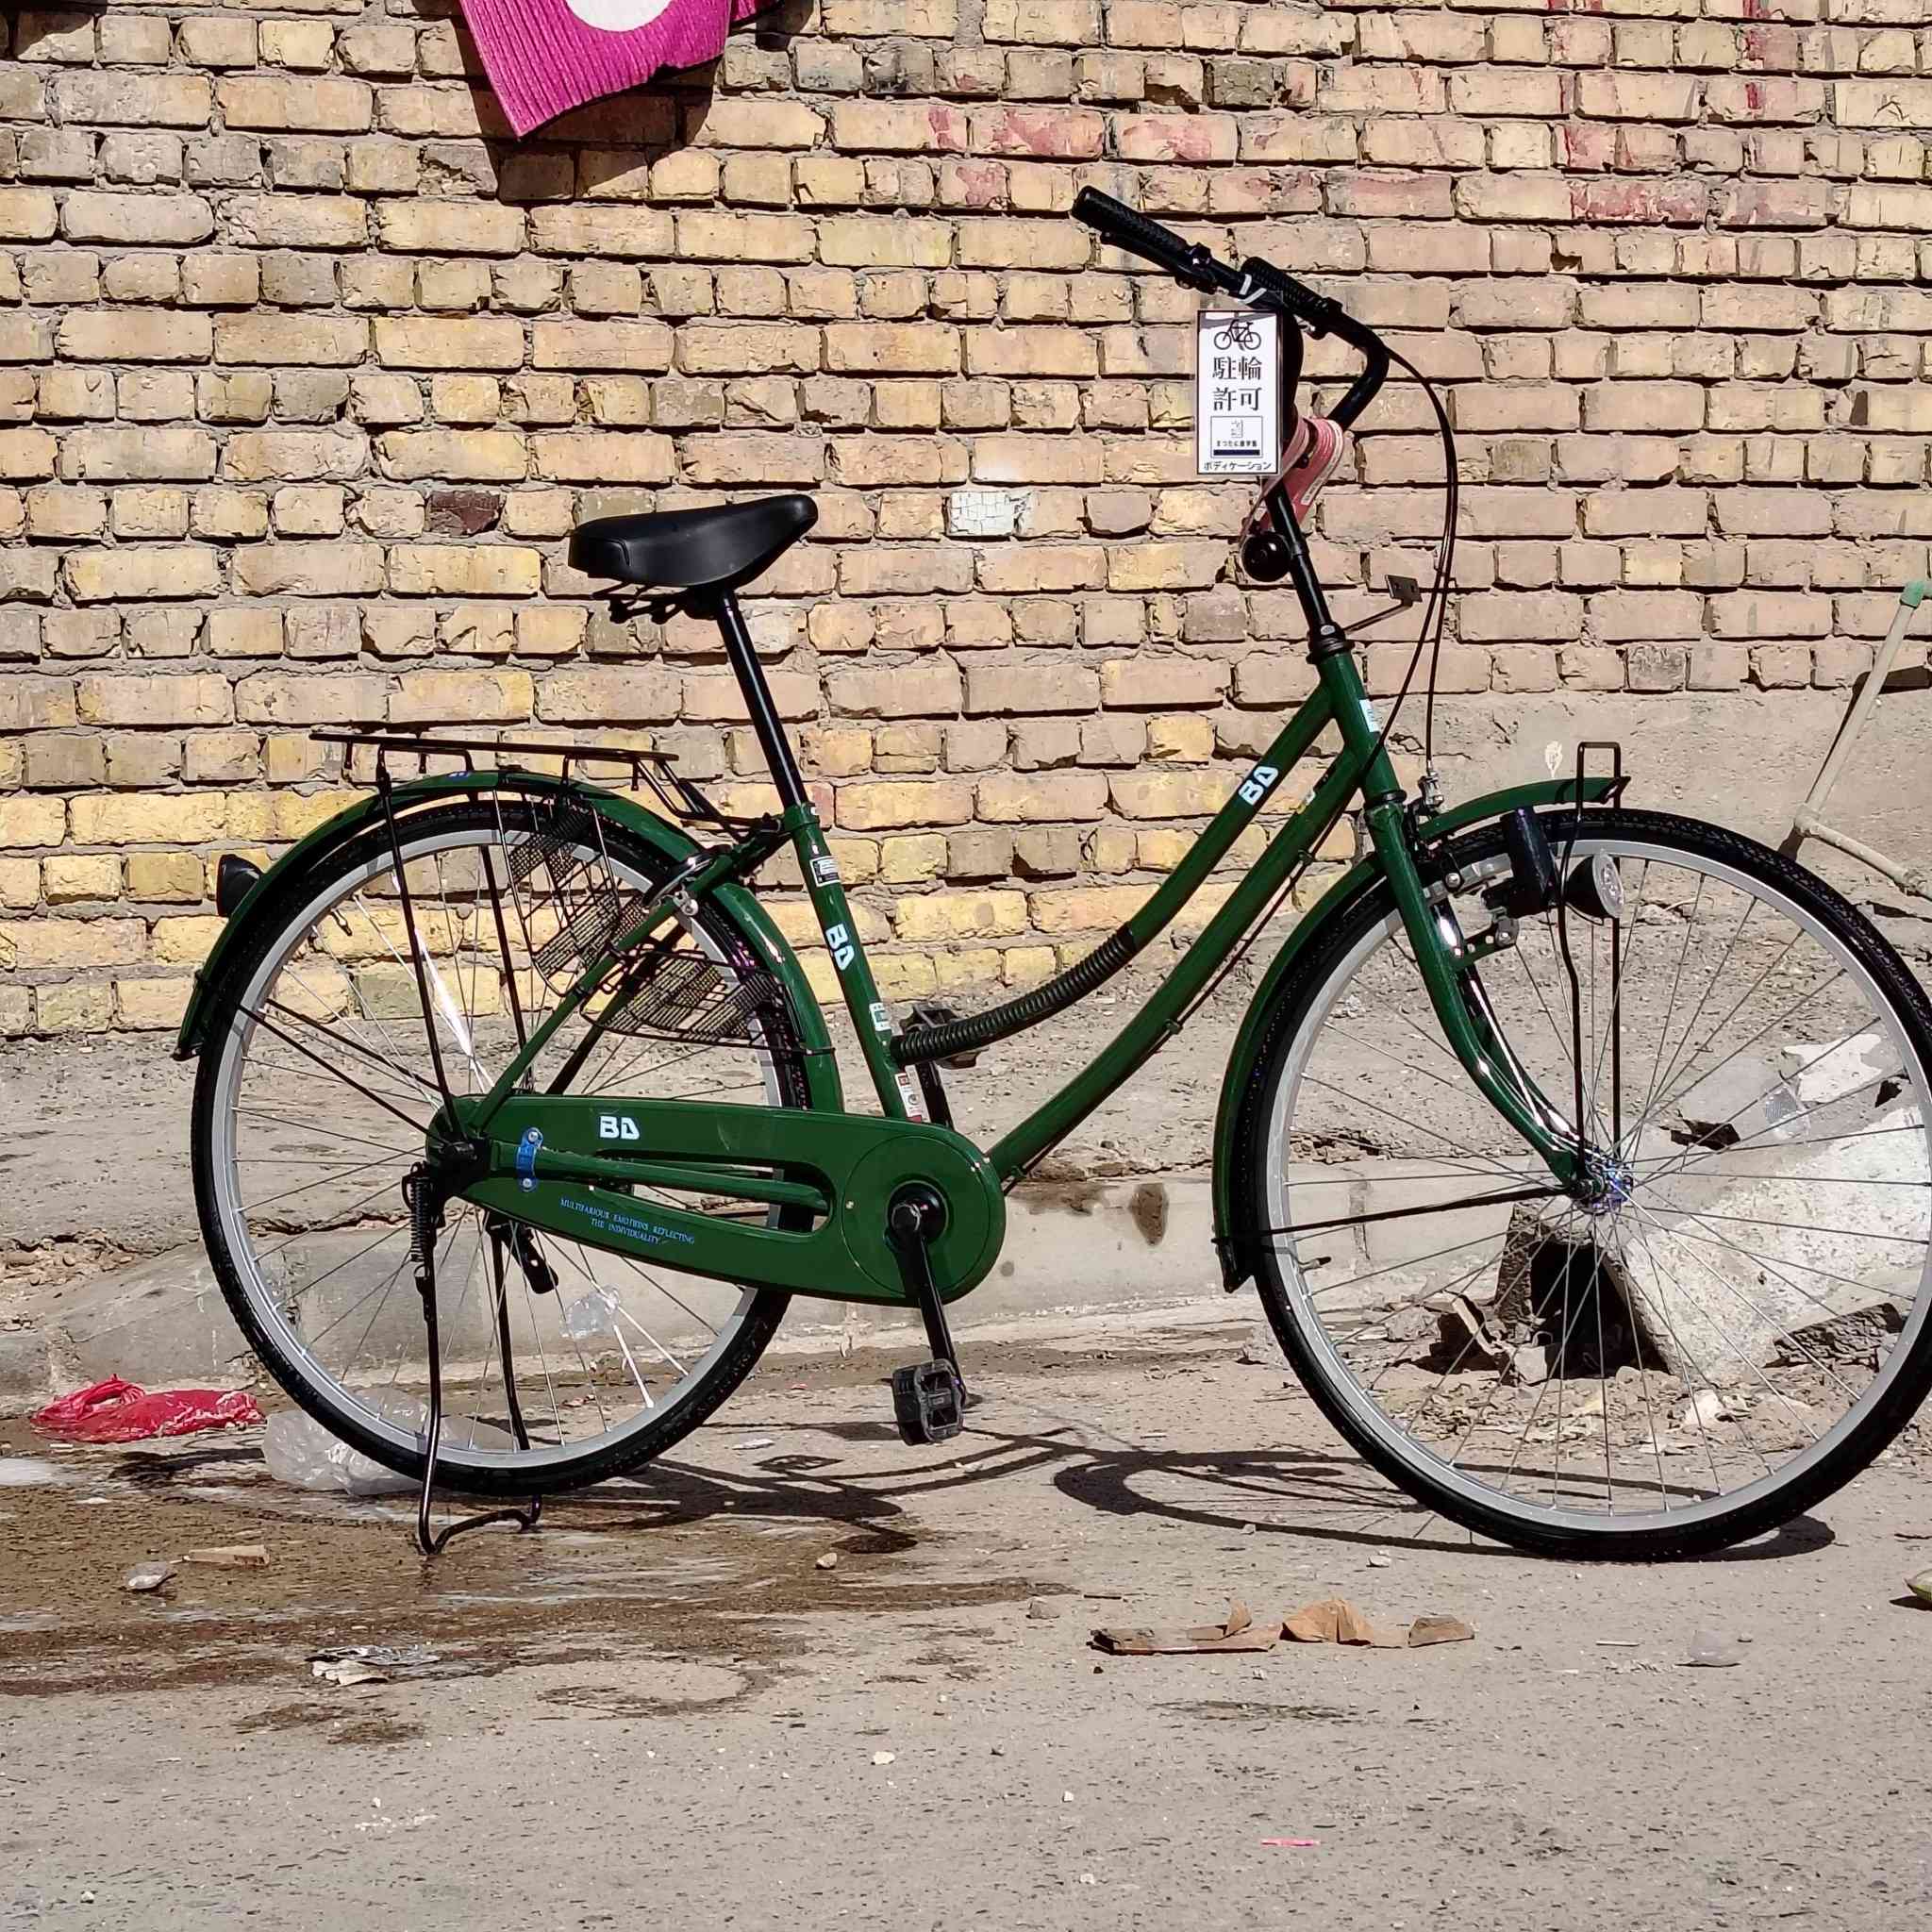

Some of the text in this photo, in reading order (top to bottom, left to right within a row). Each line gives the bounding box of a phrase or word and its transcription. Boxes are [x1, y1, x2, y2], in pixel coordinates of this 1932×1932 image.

[1212, 356, 1262, 380] 駐輪
[1212, 387, 1262, 411] 許可
[591, 1218, 605, 1228] THE
